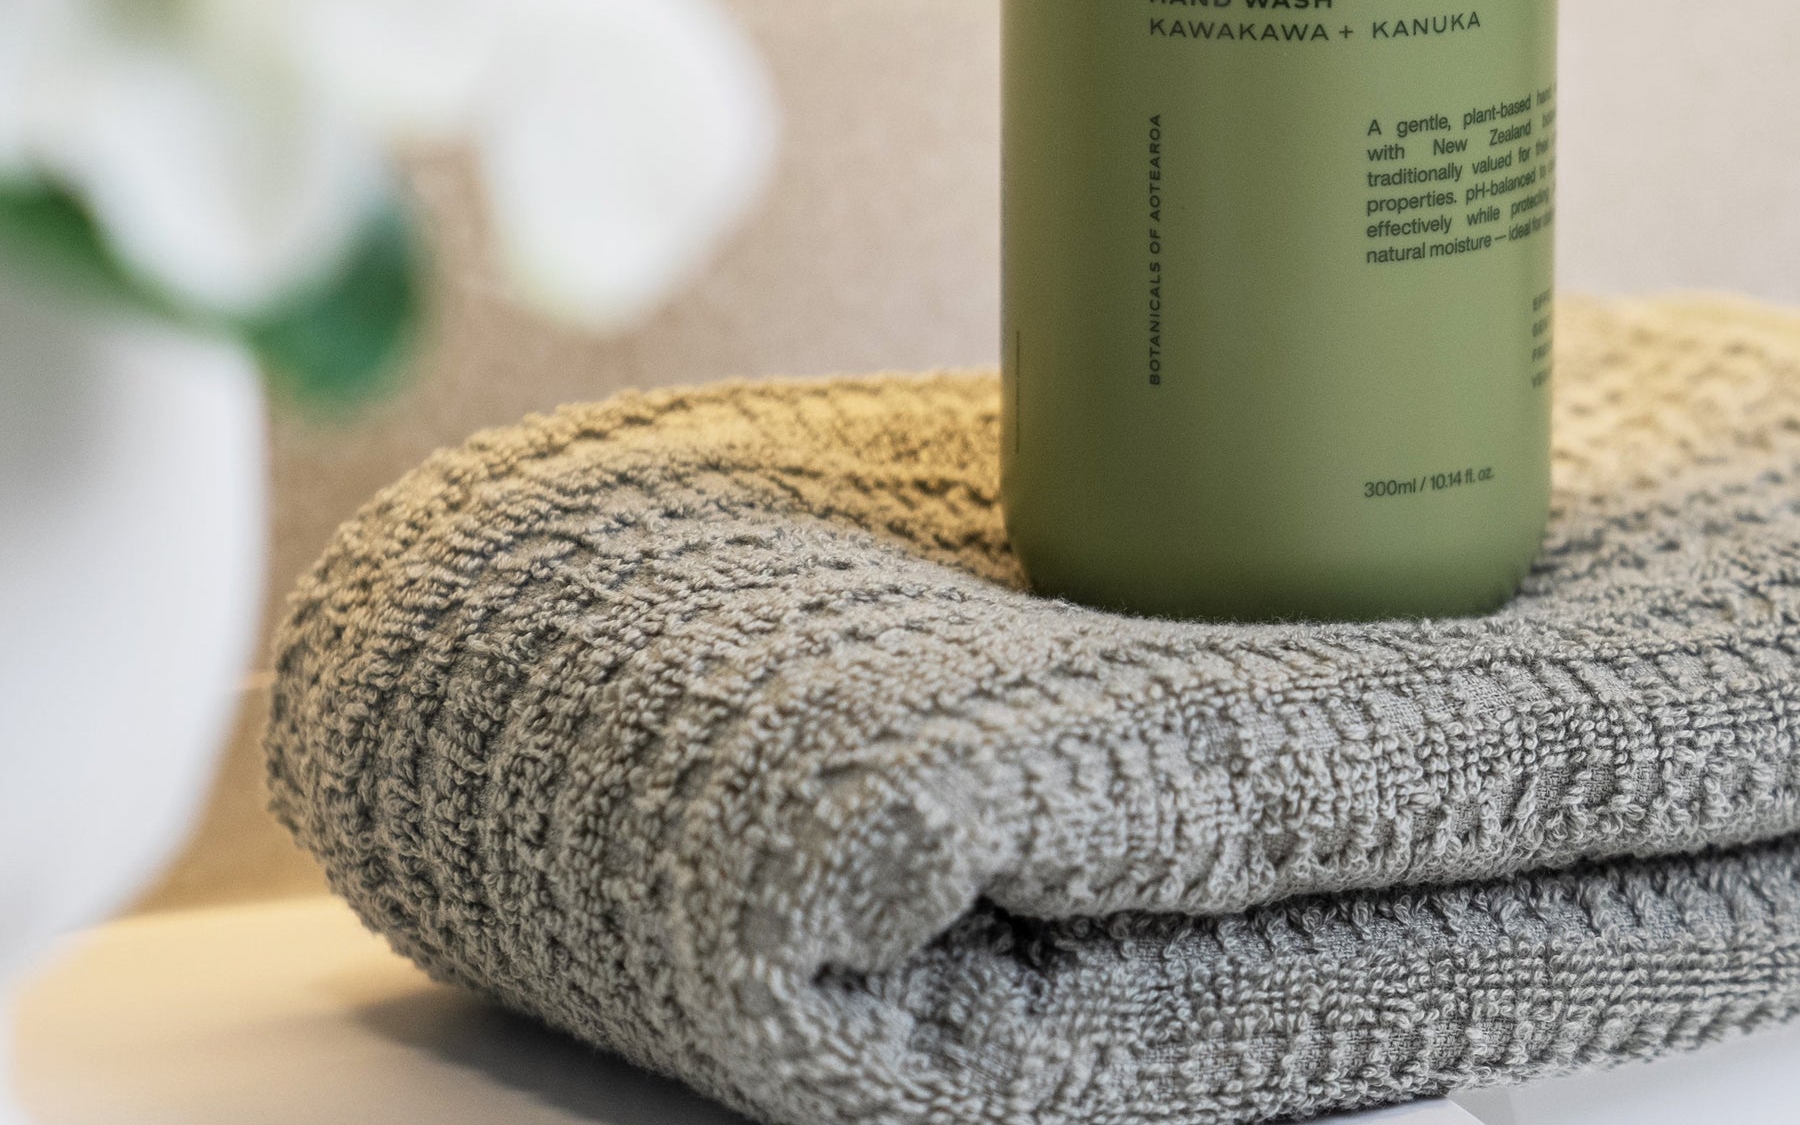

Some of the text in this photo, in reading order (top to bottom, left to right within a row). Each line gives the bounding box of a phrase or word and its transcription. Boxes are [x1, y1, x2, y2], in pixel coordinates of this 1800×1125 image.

[1150, 11, 1481, 41] KAWAKAWA + KANUKA
[1367, 119, 1382, 136] A
[1397, 113, 1451, 138] gentle,
[1463, 93, 1531, 129] plant-based
[1367, 143, 1405, 161] with
[1433, 138, 1468, 156] New
[1489, 118, 1532, 146] Zealand
[1367, 162, 1463, 188] traditionally
[1472, 150, 1512, 174] valued
[1518, 146, 1531, 163] for
[1367, 191, 1457, 217] properties.
[1466, 167, 1536, 205] pH-balanced
[1367, 214, 1452, 238] effectively
[1467, 205, 1500, 226] while
[1367, 242, 1426, 264] natural
[1430, 233, 1492, 258] moisture
[1508, 217, 1531, 241] ideal
[1149, 114, 1161, 386] BOTANICALS OF AOTEAROA
[1364, 478, 1416, 498] 300ml
[1420, 476, 1427, 492] /
[1430, 470, 1462, 490] 10.14
